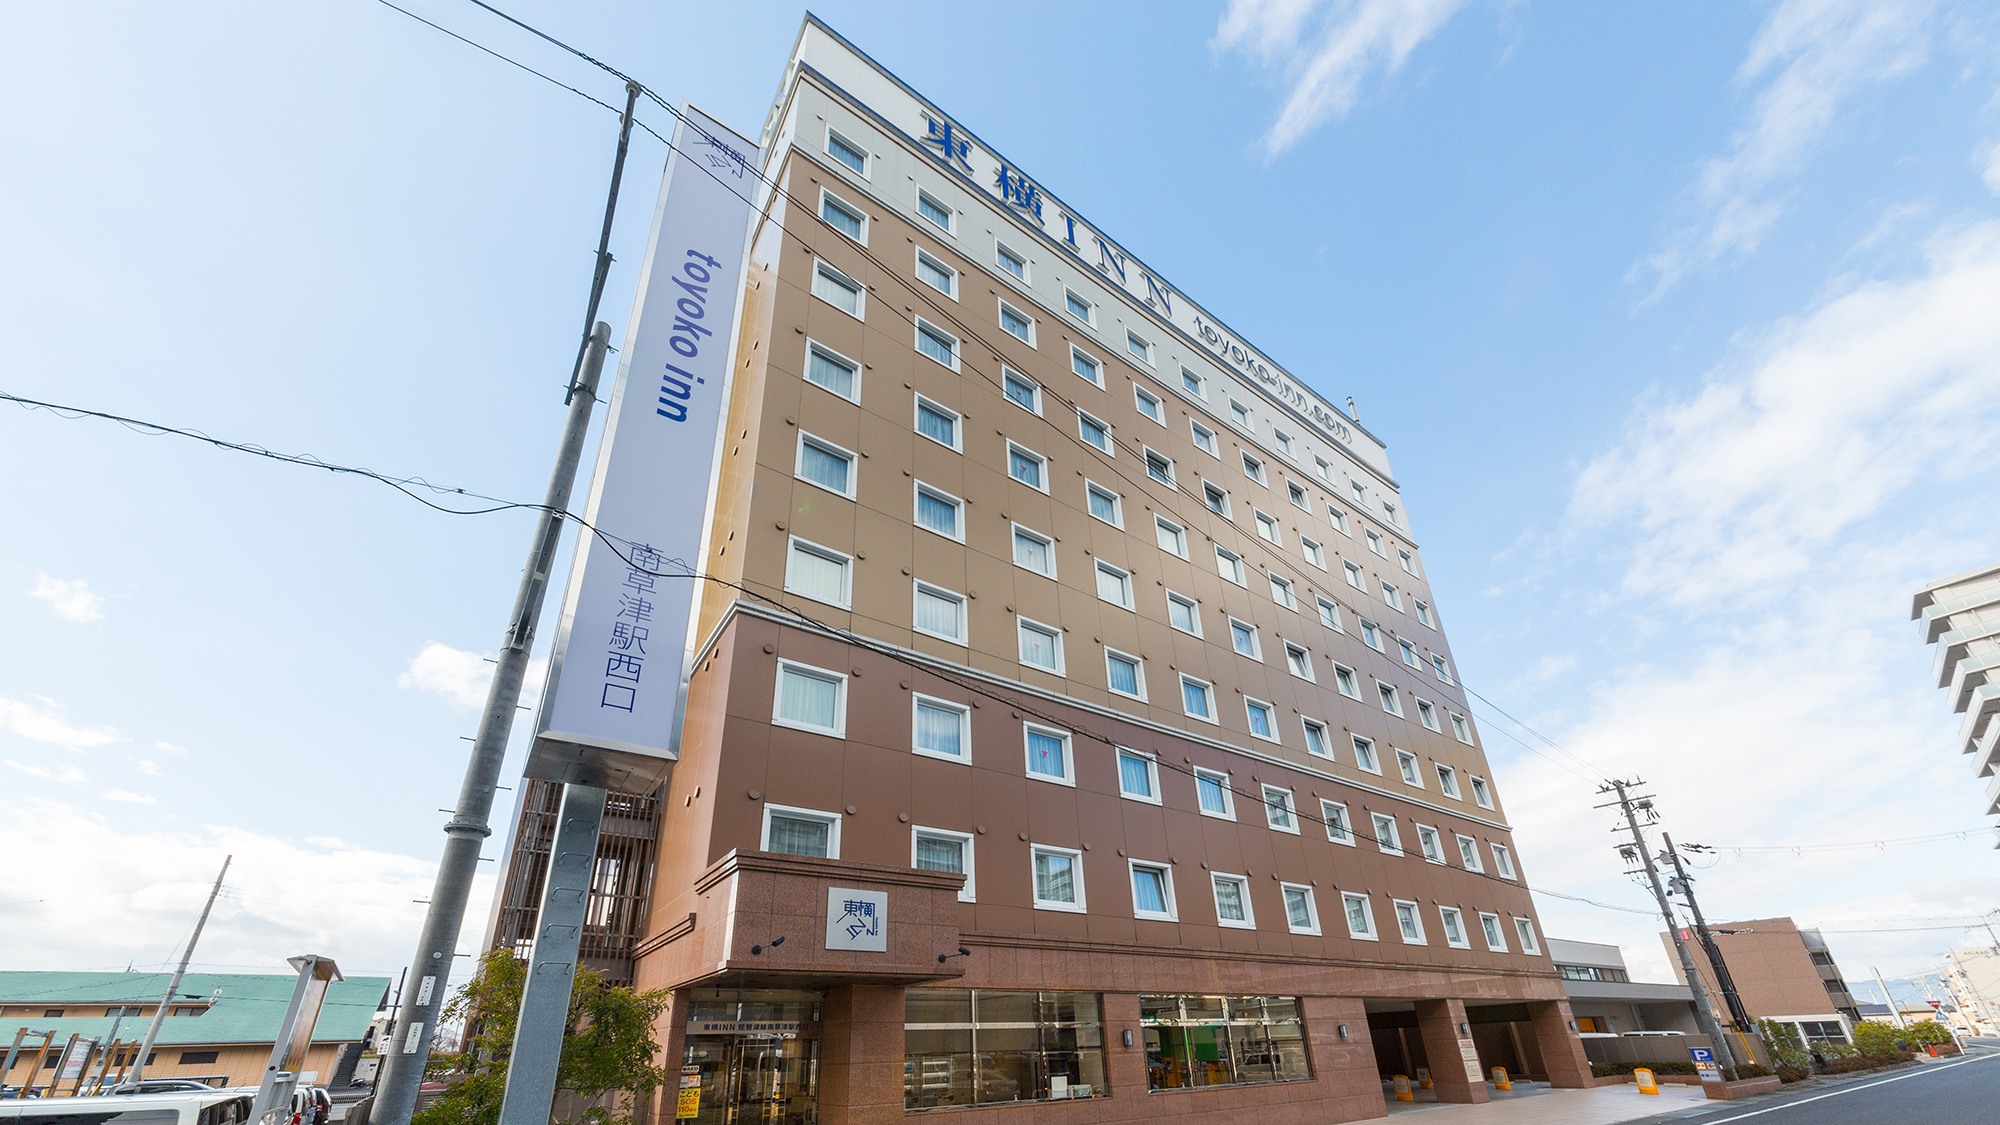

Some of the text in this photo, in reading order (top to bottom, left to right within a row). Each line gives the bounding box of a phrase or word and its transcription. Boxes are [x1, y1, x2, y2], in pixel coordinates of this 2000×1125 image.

[656, 249, 723, 423] toyoko inn
[1193, 315, 1353, 445] toyoko-inn.com
[600, 541, 664, 714] 南草津駅西口
[1693, 1049, 1709, 1061] P
[680, 1090, 700, 1098] こども
[680, 1098, 697, 1106] SOS
